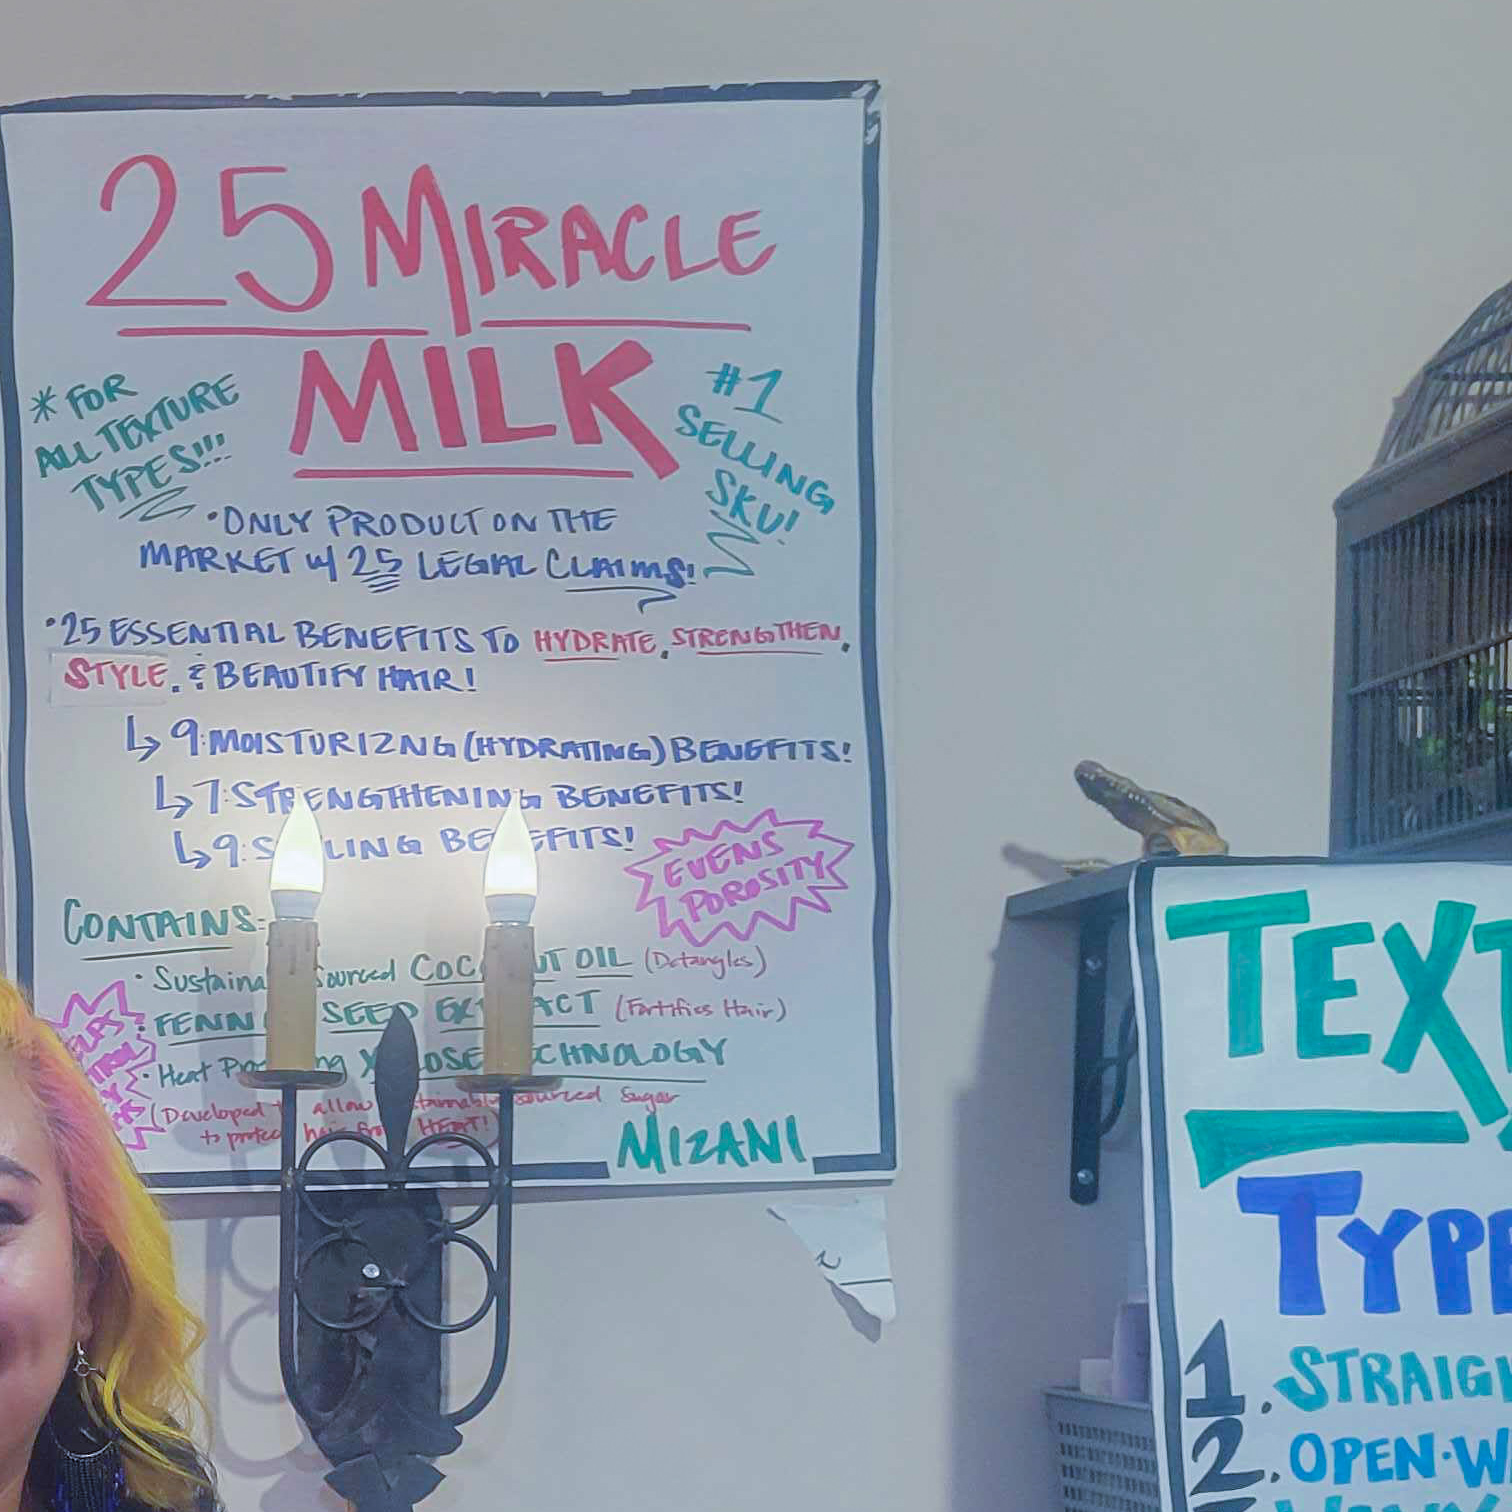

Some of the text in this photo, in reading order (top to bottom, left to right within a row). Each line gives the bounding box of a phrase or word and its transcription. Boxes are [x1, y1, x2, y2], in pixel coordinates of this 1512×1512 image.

[87, 154, 778, 338] 25 MIRACLE
[290, 338, 680, 478] MILK
[705, 362, 784, 424] #1
[35, 373, 240, 478] ALL TEXTURE
[325, 505, 486, 538] PRODUCT
[493, 512, 538, 533] ON
[547, 507, 617, 534] THE
[140, 540, 296, 574] MARKET
[346, 545, 403, 577] 25
[418, 550, 537, 581] LEGAL
[109, 617, 286, 648] ESSENTIAL
[294, 620, 476, 653] BENEFITS
[481, 625, 521, 654] TO
[215, 660, 367, 690] BEAUTIFY
[464, 729, 666, 766] (HYDRATING)
[671, 736, 853, 763] BENEFITS!
[552, 781, 744, 809] BENEFITS!
[664, 830, 785, 888] EVENS
[680, 850, 826, 923] POROSITY
[576, 945, 633, 970] OIL
[724, 997, 787, 1022] Hair)
[158, 1060, 213, 1088] Heat
[617, 1112, 807, 1175] MIZANI
